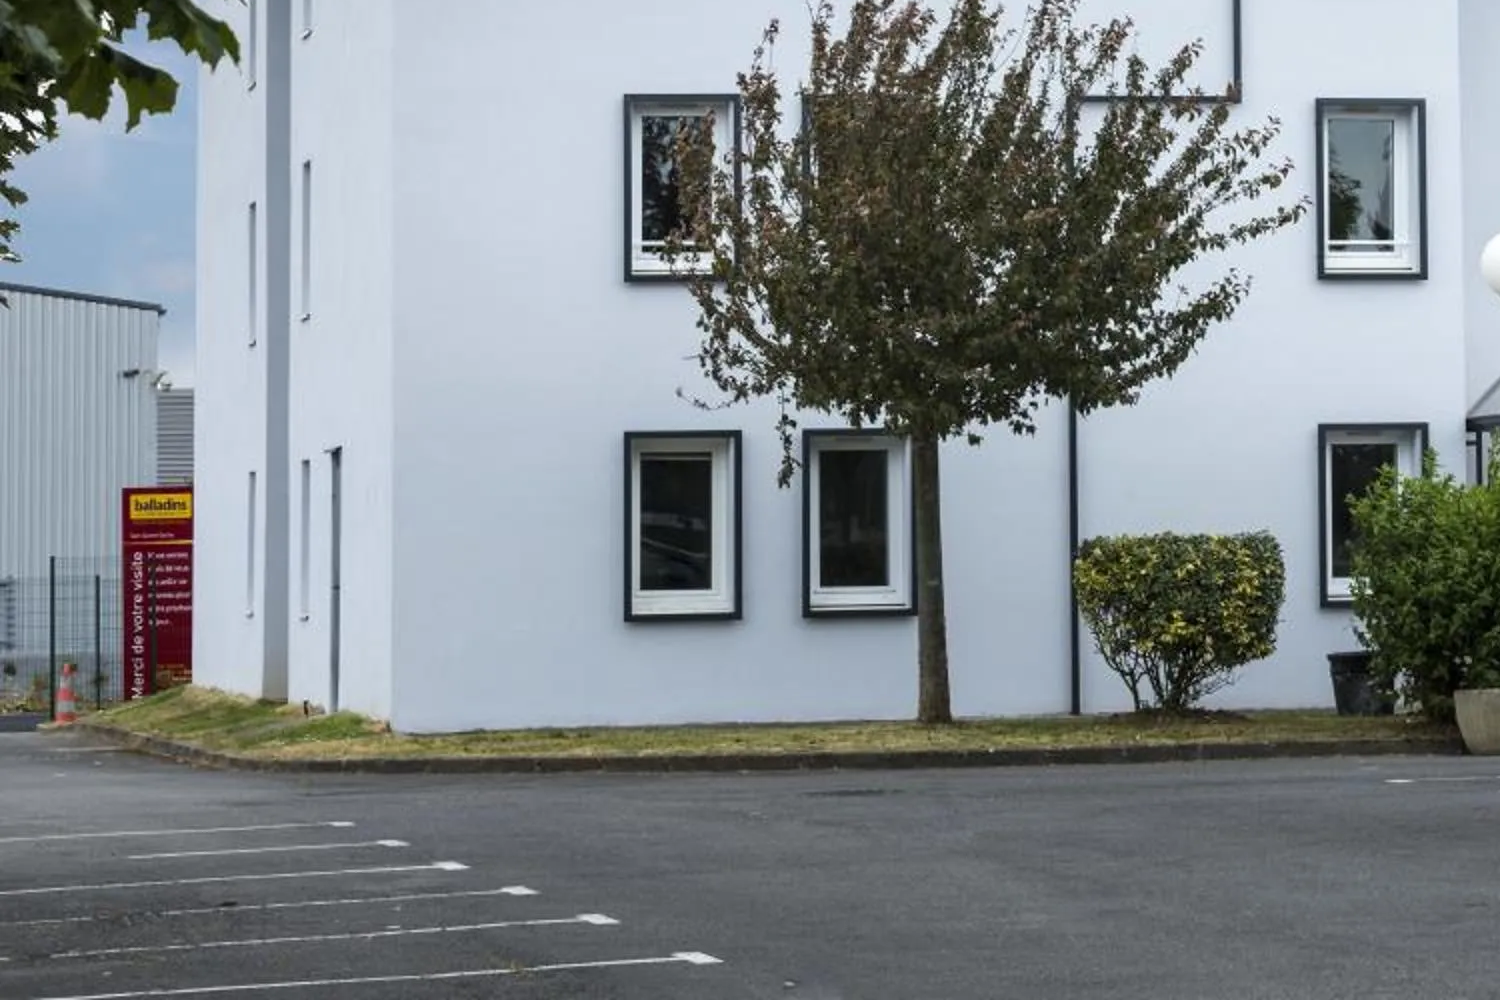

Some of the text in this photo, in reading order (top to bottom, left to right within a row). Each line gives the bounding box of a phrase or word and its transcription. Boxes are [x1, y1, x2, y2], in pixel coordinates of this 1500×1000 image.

[134, 497, 187, 512] balladins
[131, 551, 144, 700] Merci de votre visite
